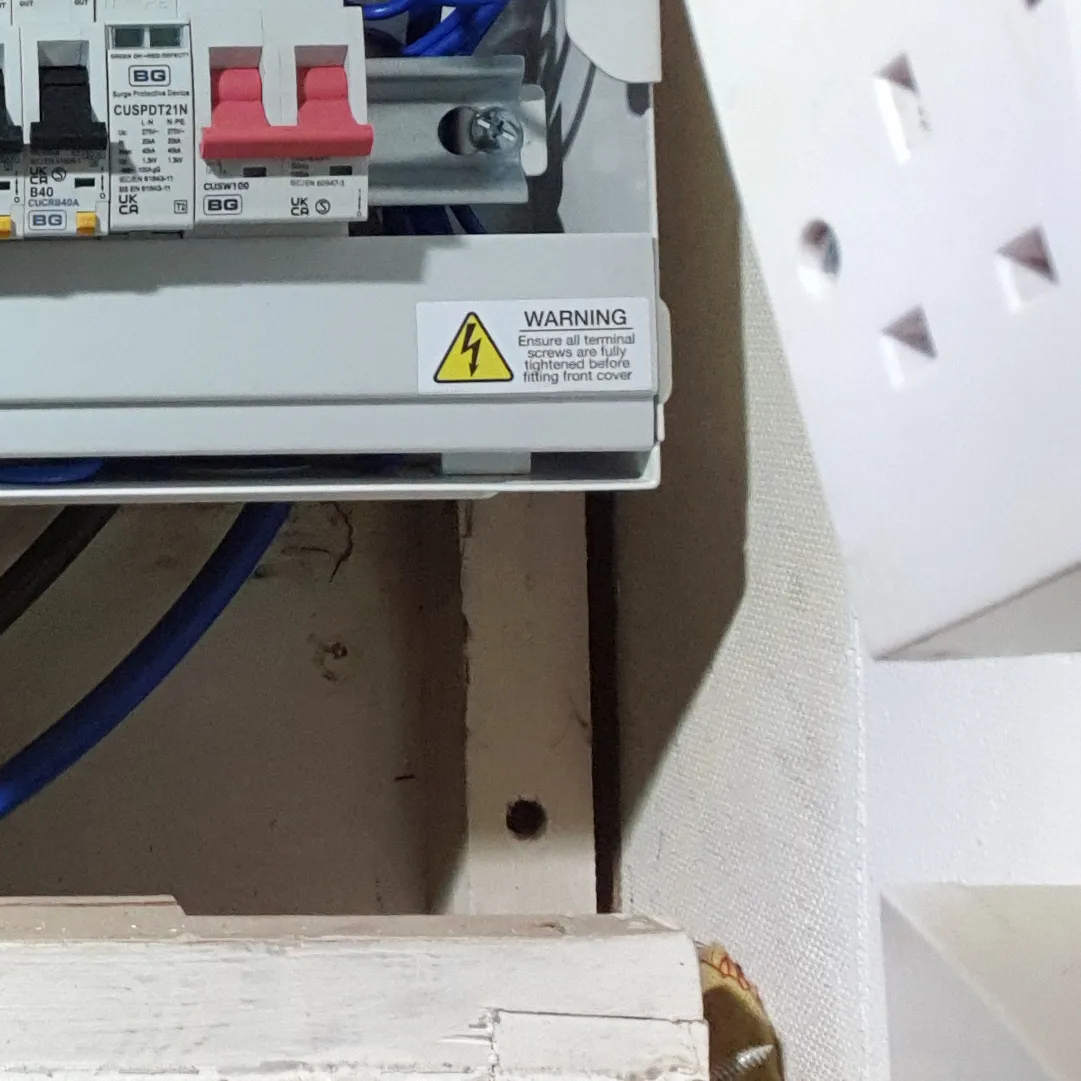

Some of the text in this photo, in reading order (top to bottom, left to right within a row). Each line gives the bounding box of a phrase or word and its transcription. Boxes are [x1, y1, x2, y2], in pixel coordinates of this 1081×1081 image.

[133, 70, 166, 82] BG
[114, 104, 188, 116] CUSPDT21N
[29, 166, 47, 175] UK
[30, 176, 48, 185] CA
[203, 182, 249, 191] CUSW100
[30, 187, 54, 197] B40
[119, 194, 137, 204] UK
[208, 199, 238, 211] BG
[291, 197, 308, 206] UK
[119, 204, 138, 215] CA
[291, 207, 309, 216] CA
[32, 214, 62, 226] BG
[524, 309, 627, 327] WARNING
[519, 333, 635, 347] Ensure all terminal
[527, 347, 626, 359] screws are fully
[524, 358, 630, 372] tightened before
[523, 370, 632, 385] fitting front cover
